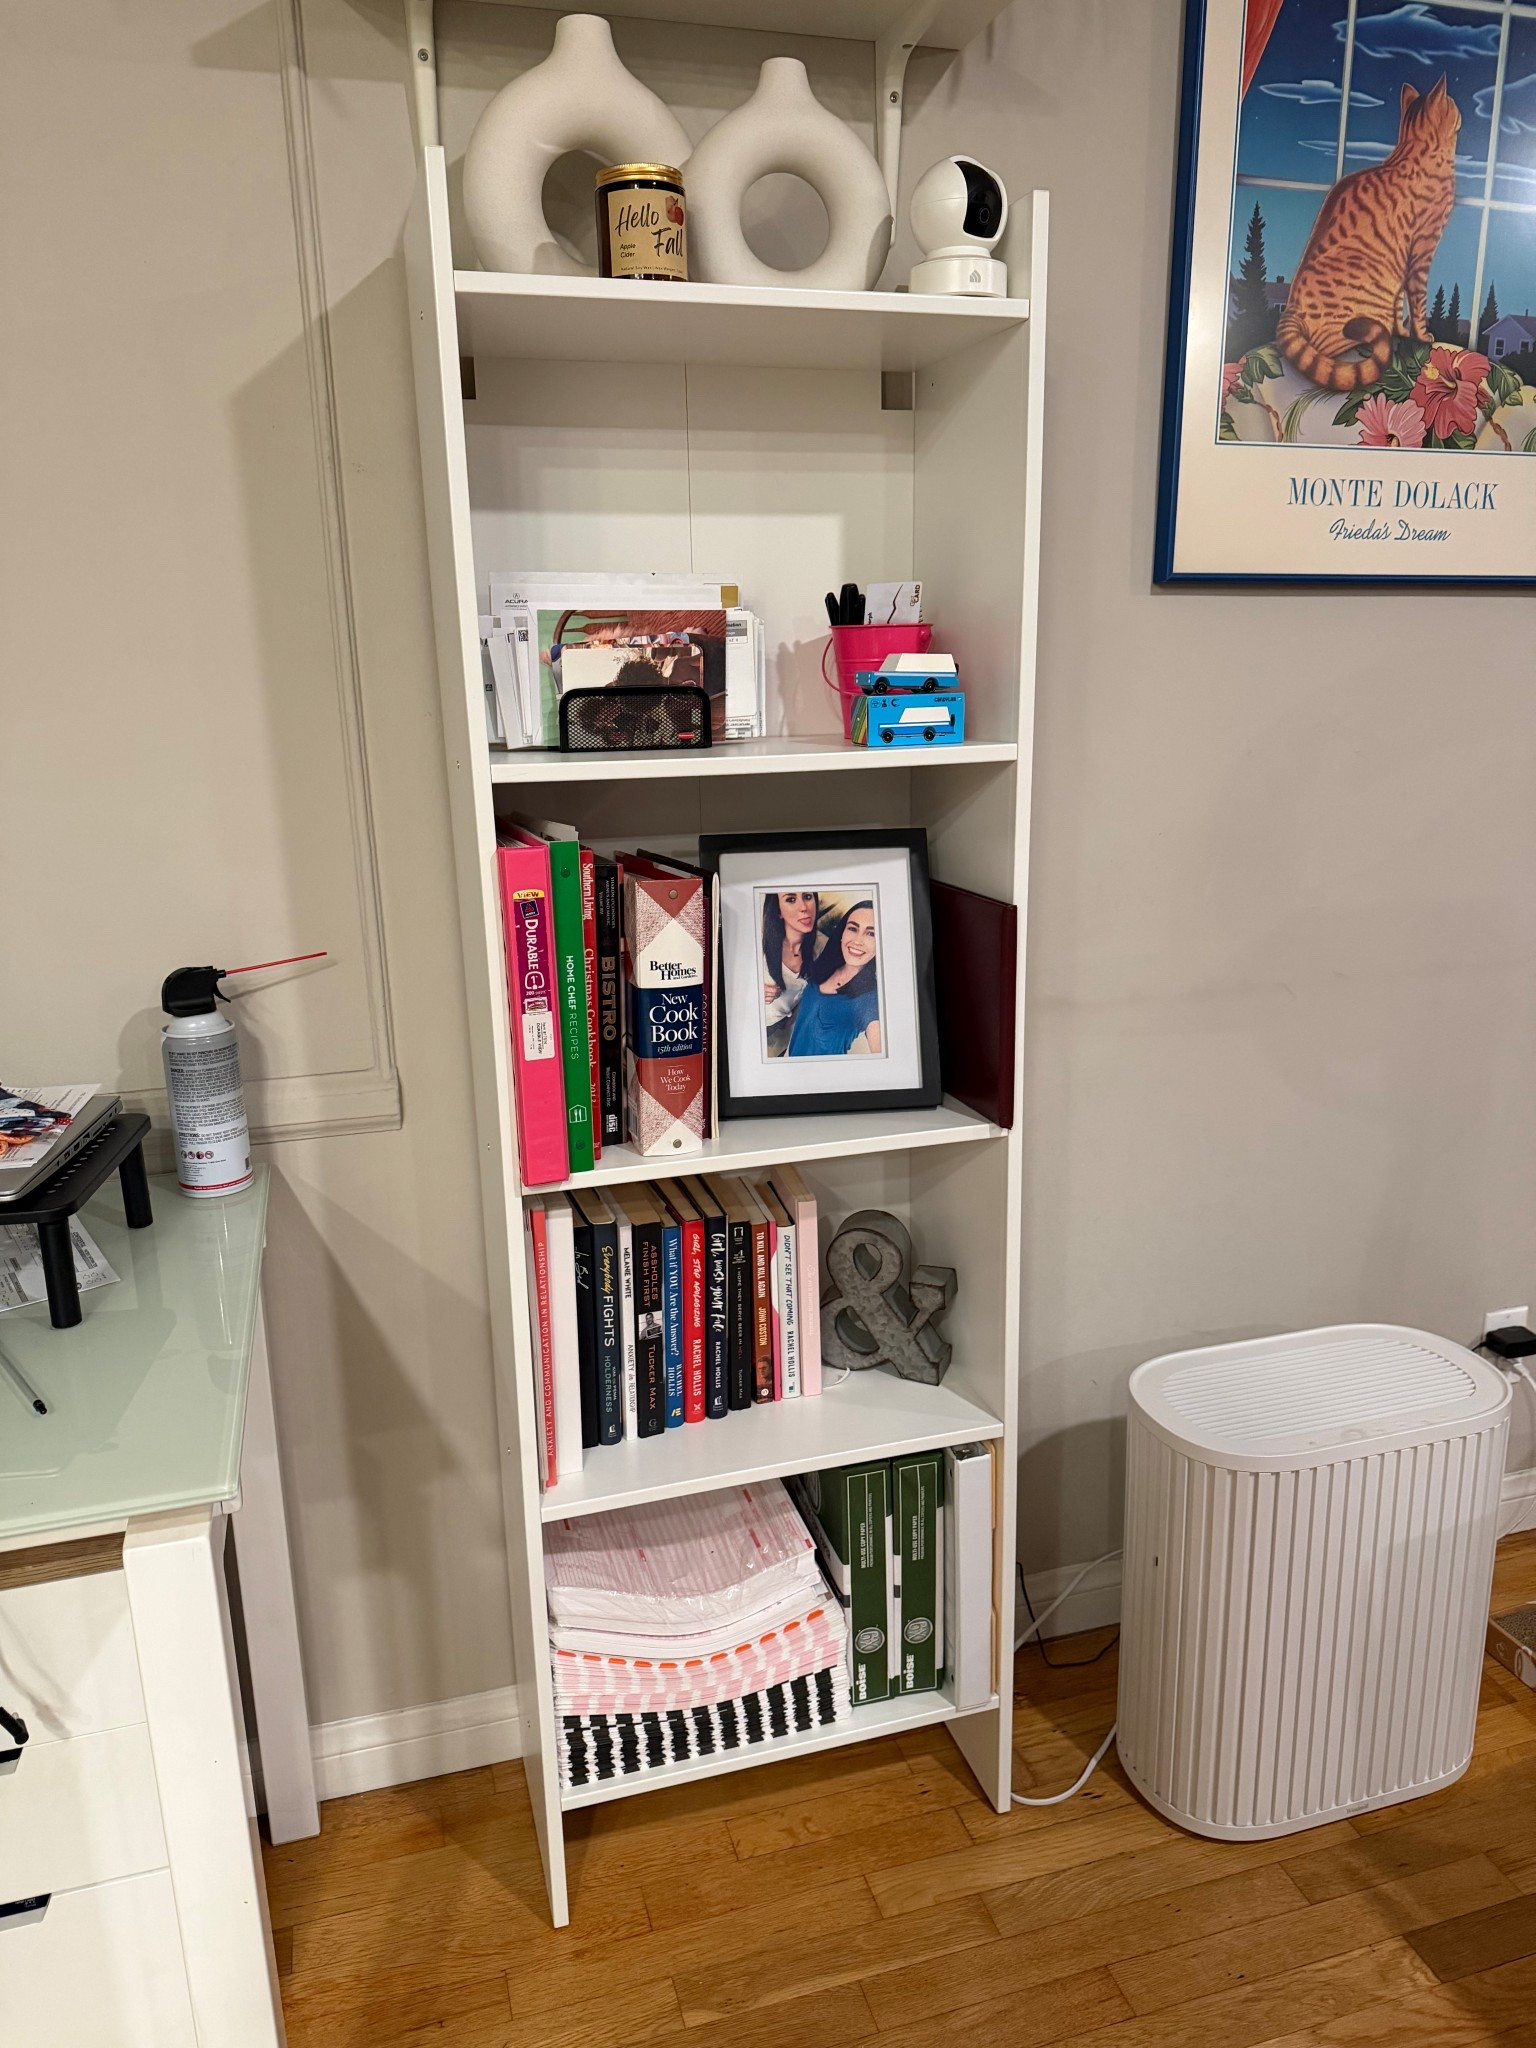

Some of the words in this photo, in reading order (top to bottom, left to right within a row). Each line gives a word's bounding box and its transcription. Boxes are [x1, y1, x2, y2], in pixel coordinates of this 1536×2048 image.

[615, 203, 660, 237] Hello
[651, 227, 683, 257] Fall
[1286, 476, 1384, 508] MONTE
[1392, 479, 1500, 510] DOLACK
[1328, 518, 1392, 541] Frieda's
[1394, 519, 1452, 542] Dream
[582, 863, 594, 896] Southern
[582, 896, 594, 920] Living
[524, 918, 538, 970] DURABLE
[566, 956, 575, 983] HOME
[584, 948, 595, 1006] Christmas
[650, 960, 682, 971] Better
[661, 967, 696, 980] Homes
[567, 985, 577, 1010] CHEF
[602, 956, 616, 1040] BISTRO
[661, 993, 688, 1006] New
[649, 1002, 699, 1024] Cook
[570, 1013, 579, 1060] RECIPES
[650, 1021, 698, 1043] Book
[658, 1044, 671, 1055] 15th
[672, 1044, 692, 1052] edition
[666, 1083, 686, 1092] Today
[673, 1074, 691, 1082] Cook
[608, 1114, 618, 1132] disc
[711, 1233, 726, 1257] Girl,
[756, 1232, 764, 1240] TO
[756, 1240, 765, 1254] KILL
[784, 1234, 792, 1262] DIDN'T
[668, 1238, 677, 1260] What
[757, 1254, 765, 1266] AND
[538, 1242, 548, 1305] RELATIONSHIP
[574, 1262, 590, 1290] Bed
[600, 1246, 614, 1294] Everybody
[650, 1245, 658, 1300] ASSHOLES
[670, 1270, 678, 1290] YOU
[712, 1260, 725, 1284] wash
[758, 1266, 766, 1280] KILL
[670, 1292, 678, 1306] Are
[710, 1286, 725, 1310] your
[758, 1280, 766, 1298] AGAIN
[542, 1308, 548, 1318] IN
[603, 1296, 615, 1346] FIGHTS
[670, 1308, 678, 1320] the
[758, 1306, 766, 1322] JOHN
[786, 1300, 794, 1326] COMING
[670, 1322, 679, 1356] Answer?
[759, 1323, 768, 1346] COSTON
[787, 1330, 795, 1355] RACHEL
[542, 1321, 551, 1397] COMMUNICATION
[648, 1344, 656, 1384] TUCKER
[693, 1338, 702, 1368] RACHEL
[788, 1356, 796, 1378] HOLLIS
[604, 1355, 612, 1413] HOLDERNESS
[668, 1367, 676, 1397] HOLLIS
[693, 1370, 702, 1396] HOLLIS
